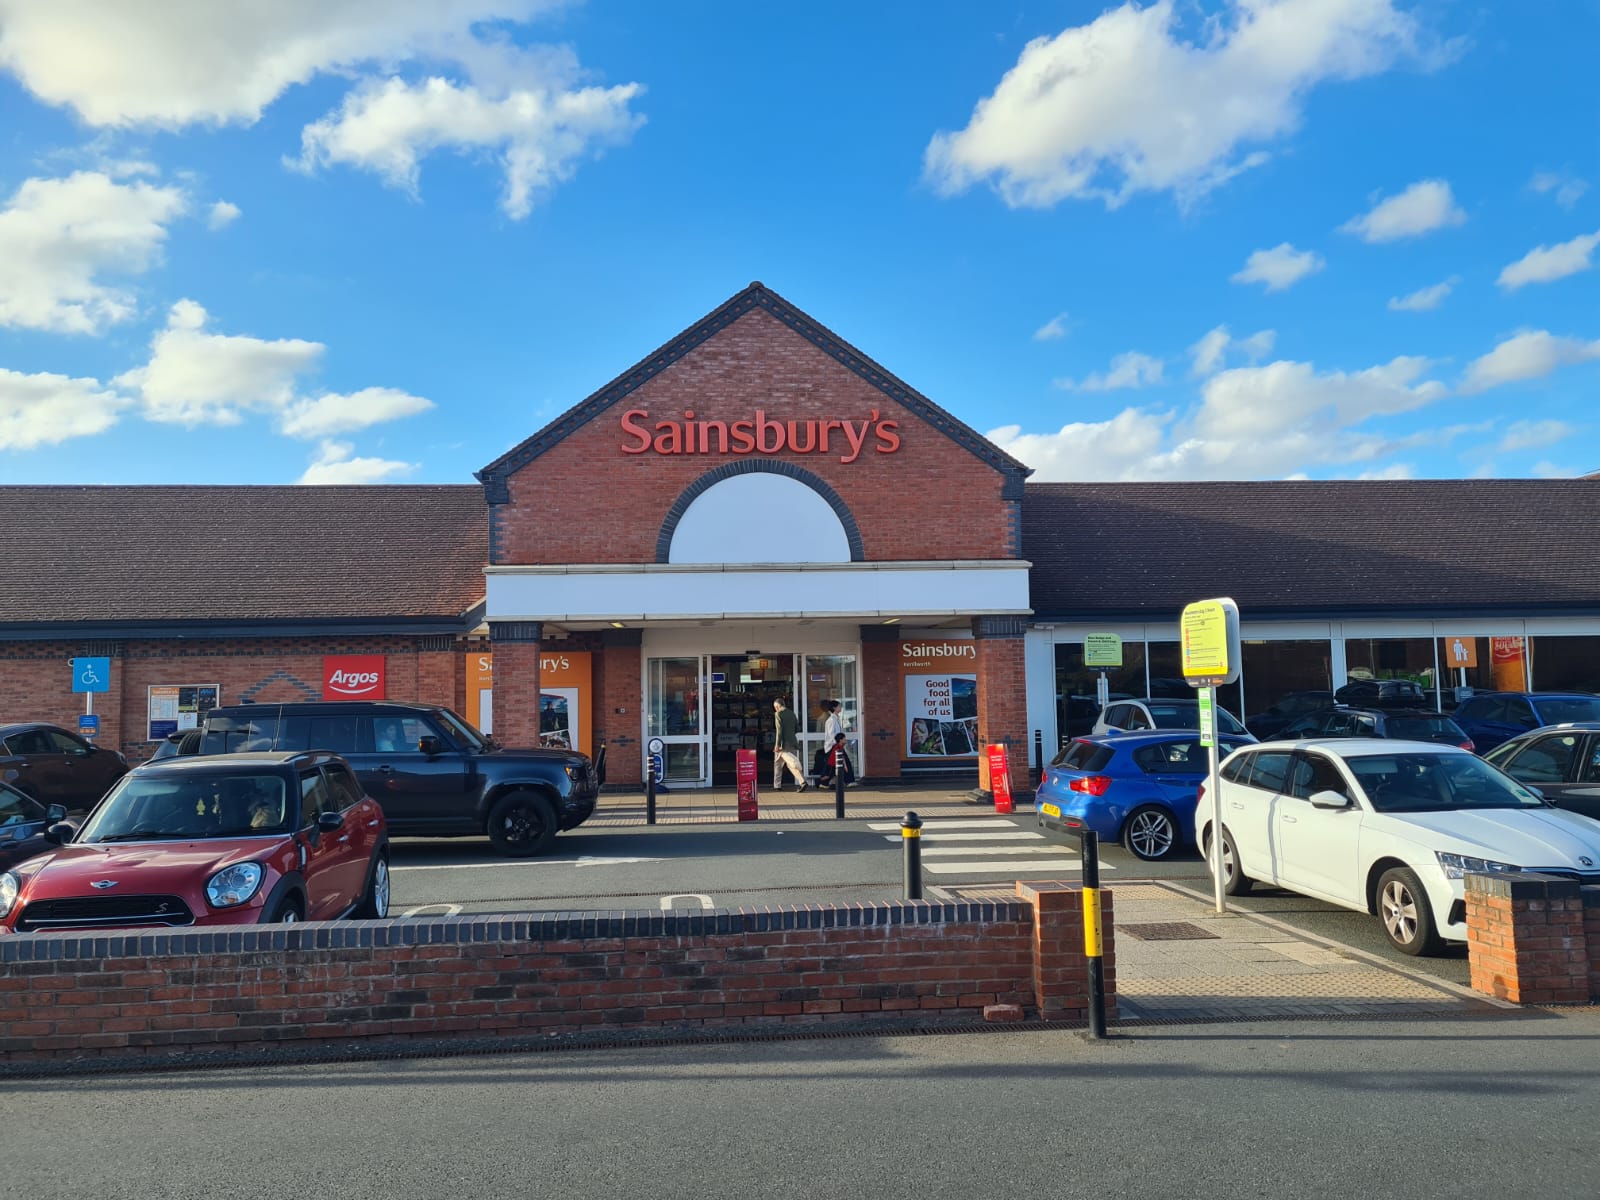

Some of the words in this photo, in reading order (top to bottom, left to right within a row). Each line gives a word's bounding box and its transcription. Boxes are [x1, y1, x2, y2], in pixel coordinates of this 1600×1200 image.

[621, 409, 901, 463] Sainsbury's
[329, 669, 379, 687] Argos
[926, 680, 949, 688] Good
[929, 689, 950, 697] food
[923, 698, 936, 706] for
[939, 698, 950, 706] all
[928, 708, 938, 716] of
